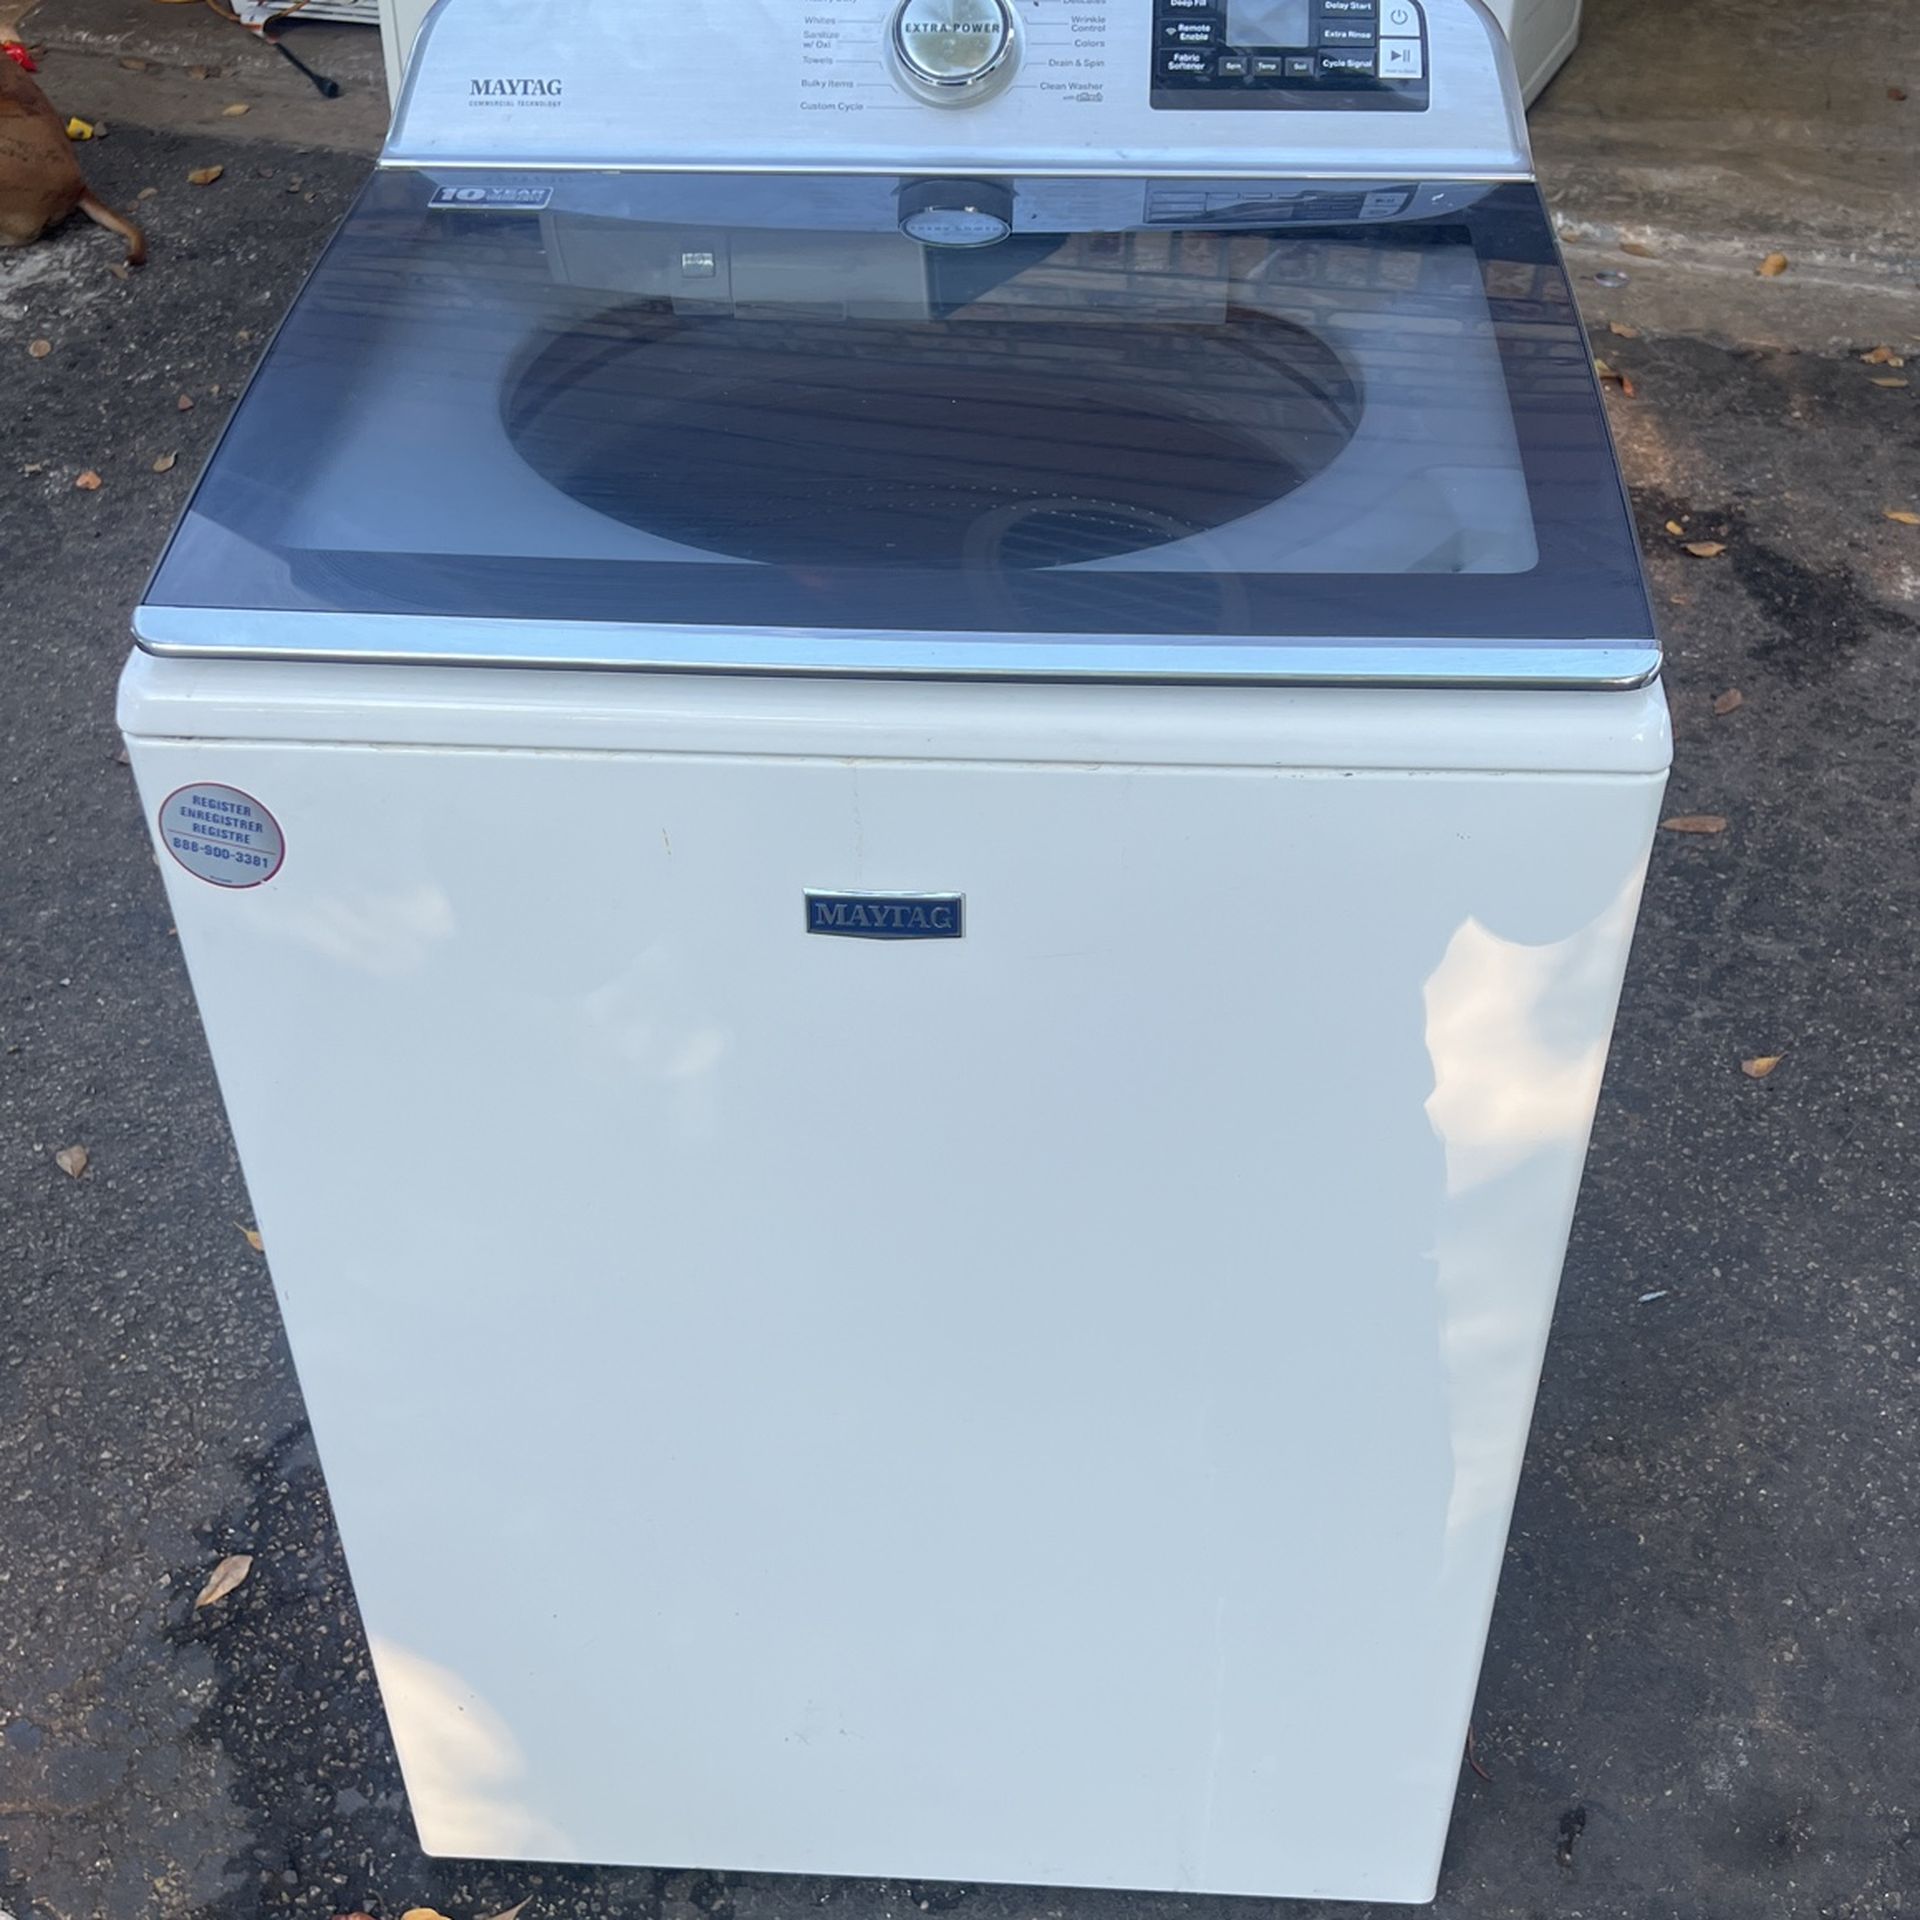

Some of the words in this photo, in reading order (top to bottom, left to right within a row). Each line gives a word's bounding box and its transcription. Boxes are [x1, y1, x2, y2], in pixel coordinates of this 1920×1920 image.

[1325, 1, 1349, 10] Delay
[1350, 2, 1371, 10] Start
[804, 16, 836, 24] Whites
[905, 23, 948, 33] EXTRA
[953, 23, 1000, 33] POWER
[1071, 24, 1106, 32] Control
[803, 30, 840, 39] Sanitize
[1324, 30, 1346, 38] Extra
[1348, 30, 1371, 38] Rinse
[1074, 39, 1105, 47] Colors
[803, 56, 833, 64] Towels
[1174, 53, 1200, 61] Fabric
[1048, 59, 1073, 67] Drain
[1083, 59, 1104, 69] Spin
[1168, 61, 1205, 70] Softener
[1322, 59, 1346, 68] Cycle
[1347, 59, 1372, 68] Signal
[470, 79, 561, 95] MAYTAG
[801, 79, 827, 89] Bulky
[828, 79, 854, 88] Items
[1040, 82, 1067, 90] Clean
[1067, 82, 1103, 90] Washer
[800, 102, 836, 110] Custom
[838, 102, 864, 112] Cycle
[441, 187, 486, 201] 10
[192, 795, 252, 817] REGISTER
[180, 806, 263, 833] ENREGISTRER
[192, 823, 252, 845] REGISTRE
[173, 837, 269, 868] 888-900-3381
[815, 903, 952, 929] MAYTAG
